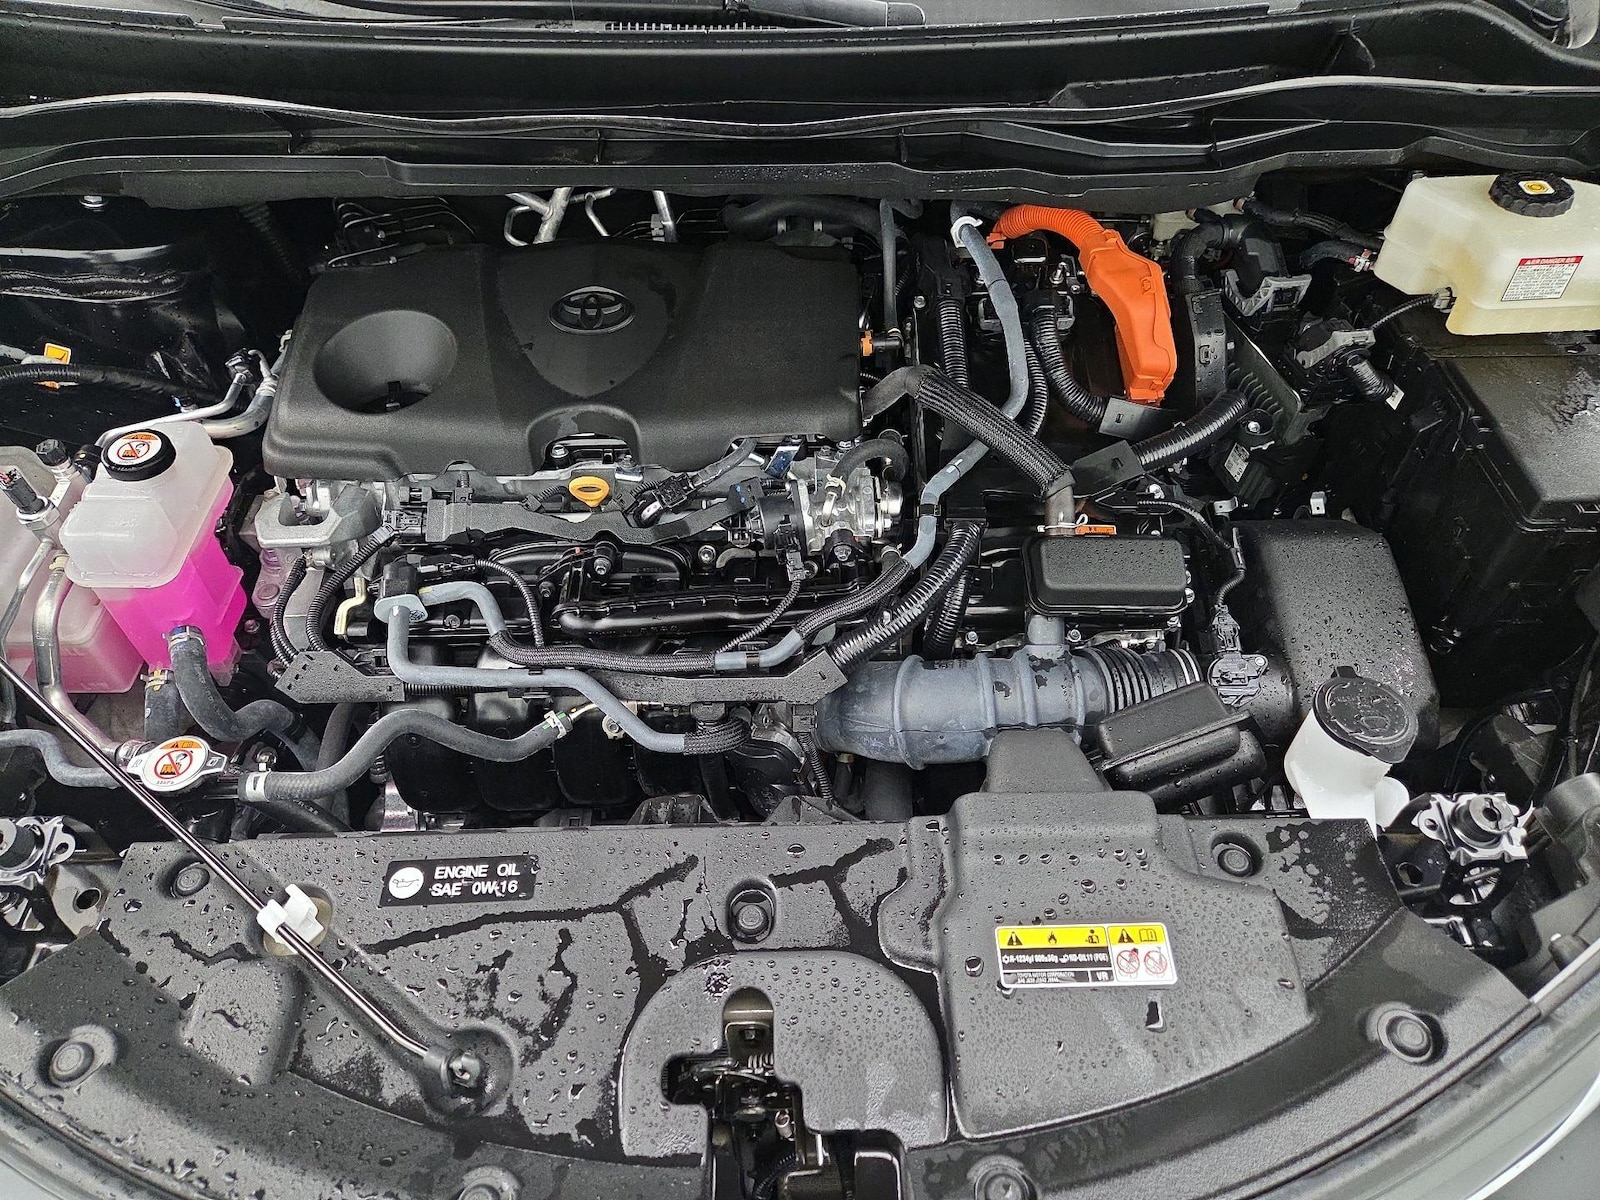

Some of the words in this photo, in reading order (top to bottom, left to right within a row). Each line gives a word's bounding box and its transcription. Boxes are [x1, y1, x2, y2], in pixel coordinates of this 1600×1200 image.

[434, 865, 489, 879] ENGINE
[497, 863, 520, 876] OIL
[431, 882, 462, 896] SAE
[472, 880, 518, 895] 0W-16
[1096, 971, 1109, 981] VR
